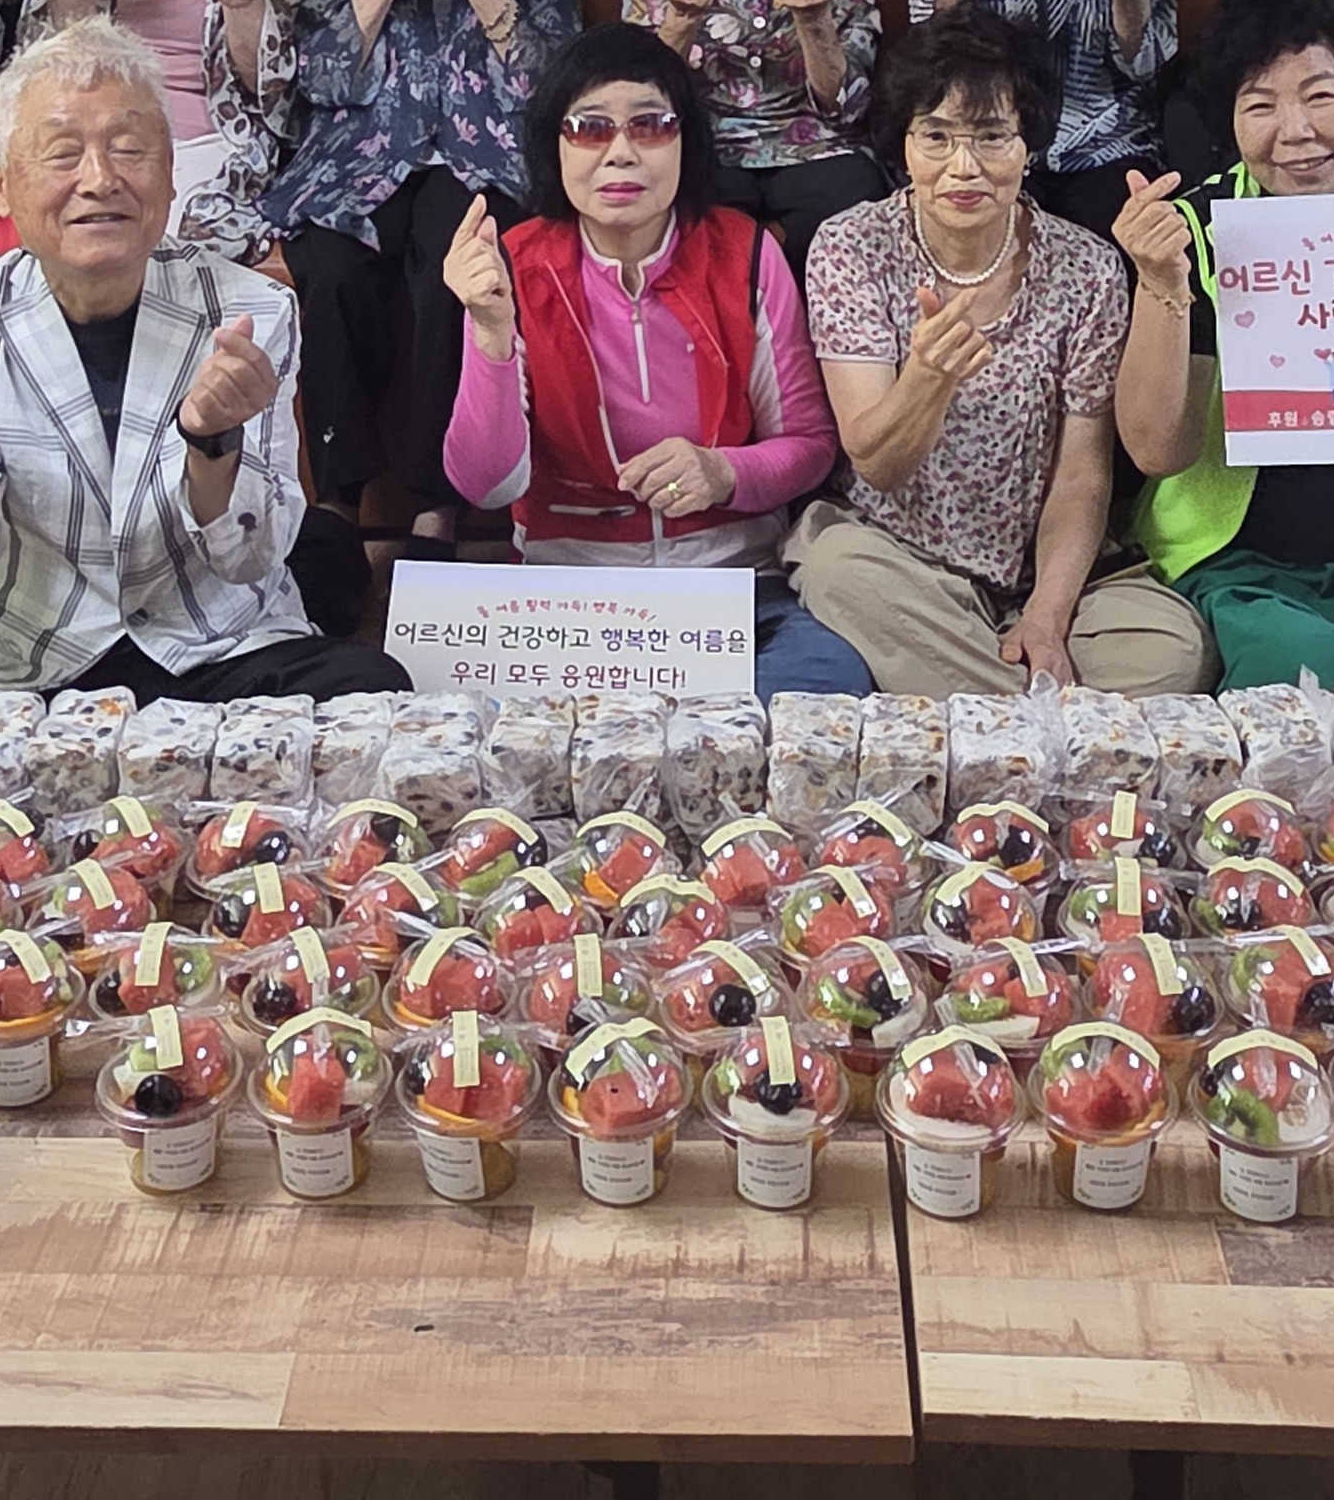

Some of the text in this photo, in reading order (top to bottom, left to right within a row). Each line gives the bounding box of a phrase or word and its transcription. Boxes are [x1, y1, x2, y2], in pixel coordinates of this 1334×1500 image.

[1219, 260, 1311, 296] 어르신
[1267, 410, 1298, 426] 후원
[393, 622, 748, 655] 어르신의 건강하고 행복한 여름을
[450, 661, 687, 691] 우리 모두 응원합니다!
